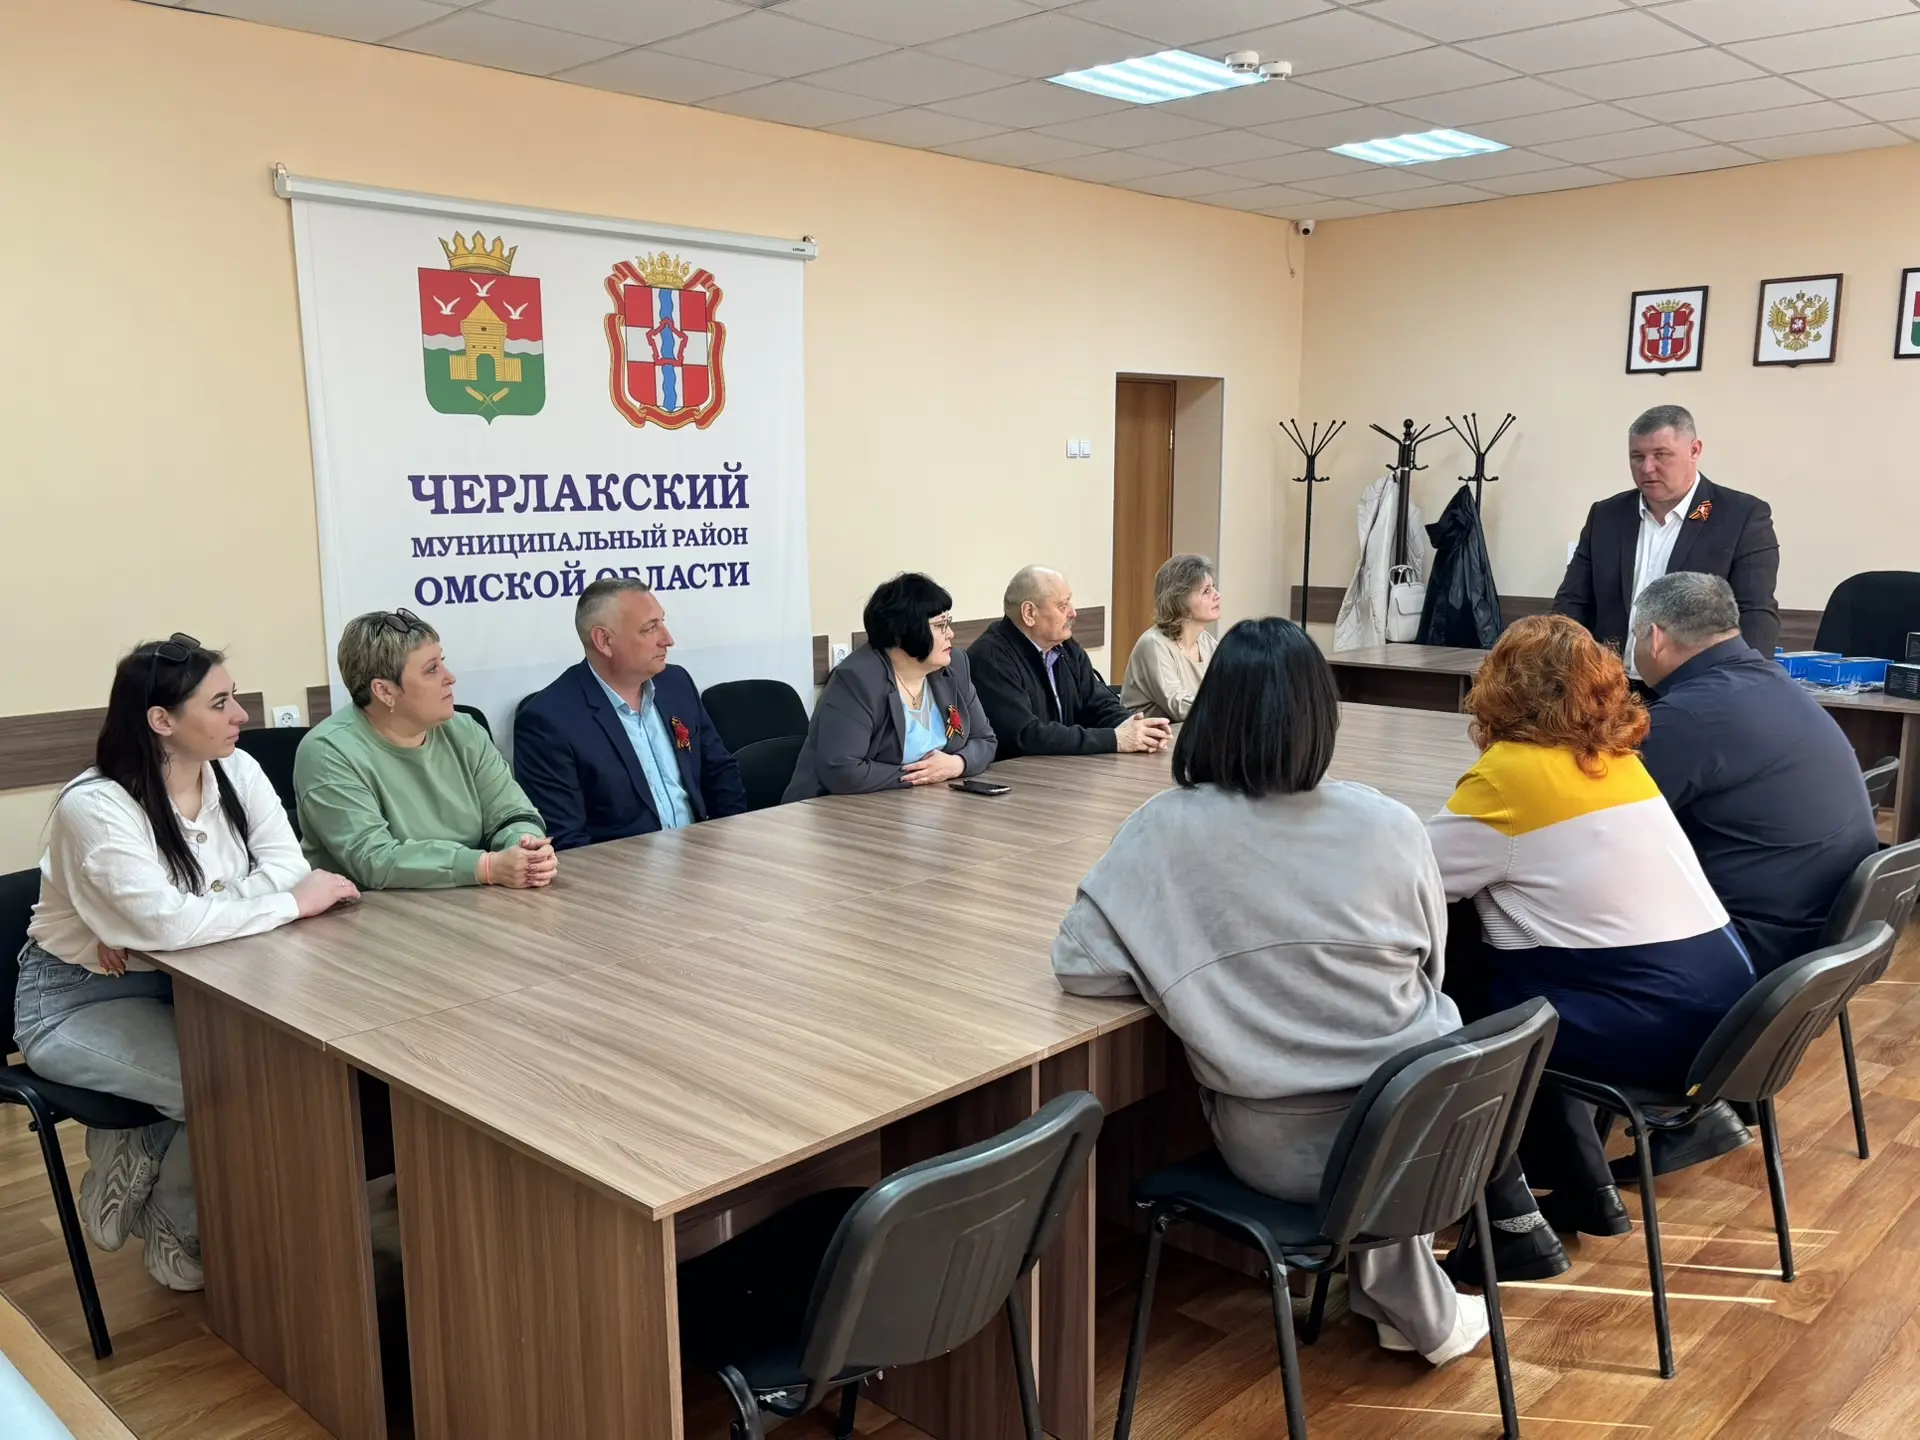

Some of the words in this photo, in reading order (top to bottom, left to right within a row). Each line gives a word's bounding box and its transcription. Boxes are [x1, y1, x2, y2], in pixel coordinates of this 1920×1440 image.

[407, 461, 750, 515] ЧЕРЛАКСКИЙ
[411, 523, 667, 559] МУНИЦИПАЛЬНЫЙ
[672, 522, 749, 547] РАЙОН
[414, 560, 586, 606] ОМСКОЙ
